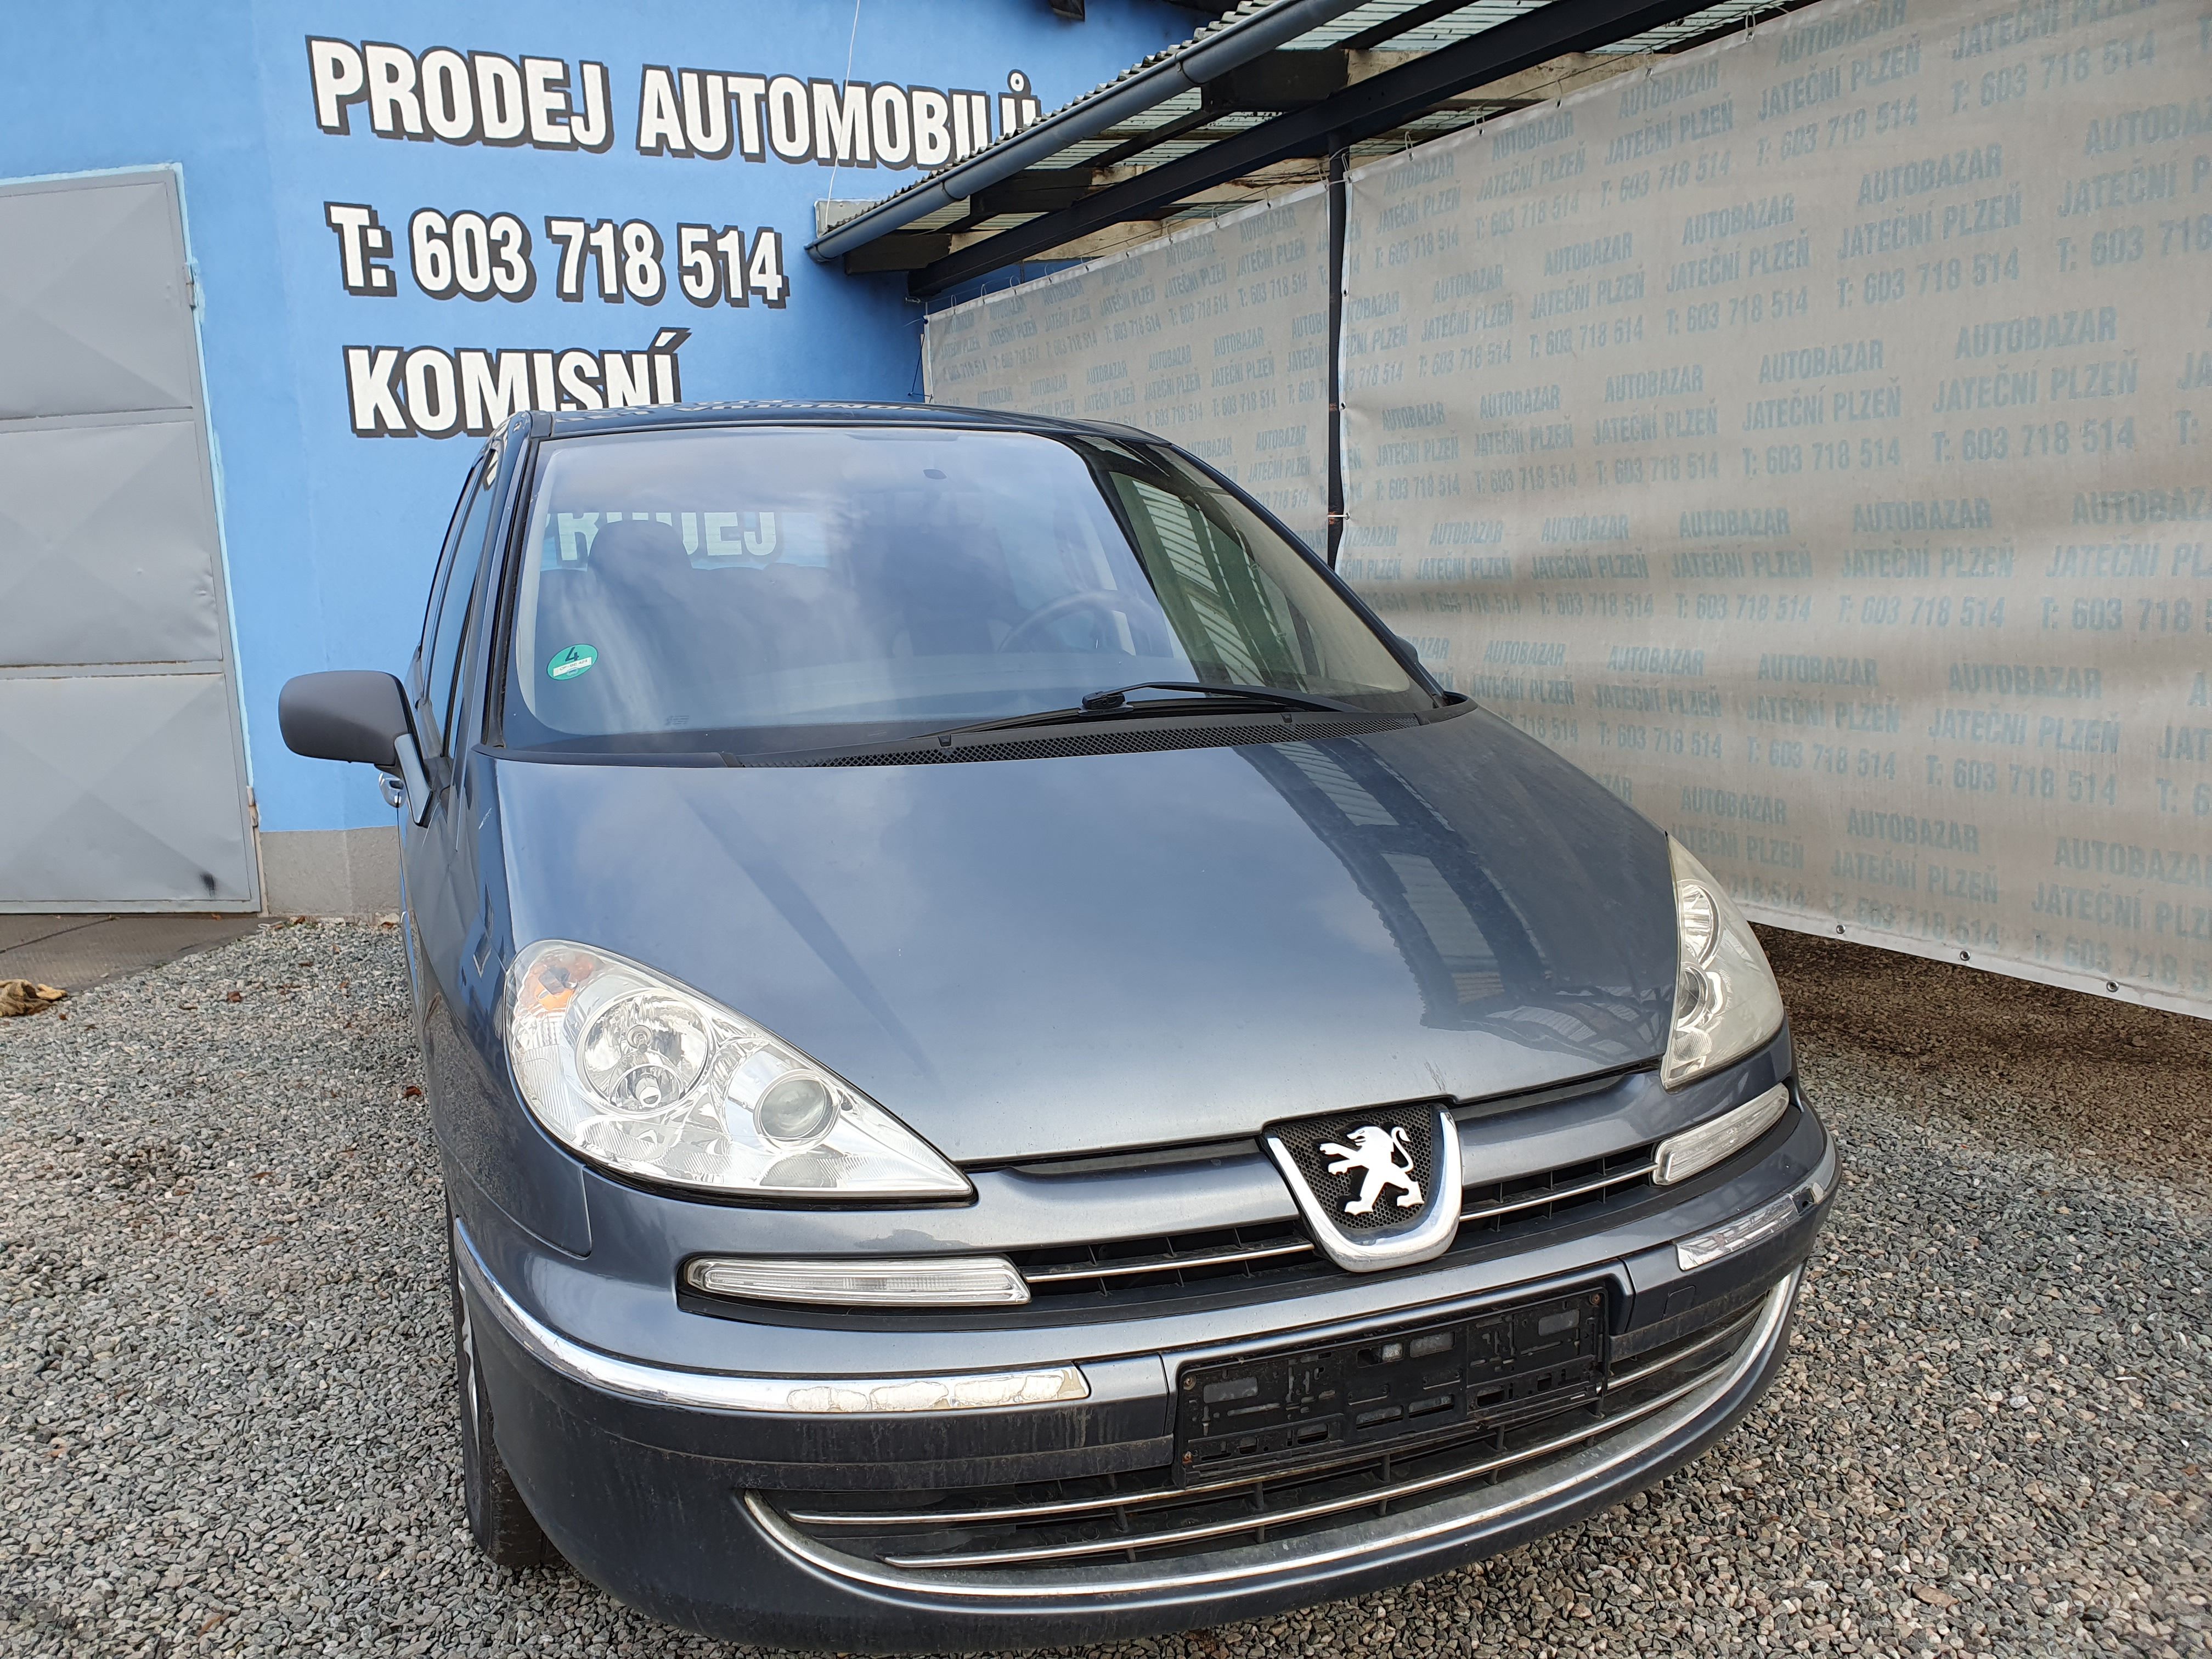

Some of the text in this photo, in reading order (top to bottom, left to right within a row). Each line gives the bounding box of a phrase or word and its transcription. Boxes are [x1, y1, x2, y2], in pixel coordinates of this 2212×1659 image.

[1619, 58, 1719, 119] AUTOBAZAR
[1758, 32, 1921, 121] JATEČNÍ PLZEŇ
[1980, 61, 2027, 106] 603
[2041, 45, 2089, 89] 718
[2102, 29, 2154, 75] 514
[305, 35, 612, 154] PRODEJ
[1605, 92, 1734, 165] JATEČNÍ PLZEŇ
[1781, 123, 1818, 161] 603
[1828, 109, 1866, 148] 718
[1876, 93, 1917, 134] 514
[1620, 170, 1649, 202] 603
[1659, 160, 1690, 192] 718
[1696, 151, 1731, 182] 514
[1858, 142, 2002, 206] AUTOBAZAR
[2056, 149, 2178, 217] JATEČNÍ
[1240, 207, 1296, 243] AUTOBAZAR
[1682, 193, 1795, 246] AUTOBAZAR
[1837, 181, 2021, 260] JATEČNÍ PLZEŇ
[325, 201, 789, 309] T: 603 718 514
[1237, 231, 1305, 276] JATEČNÍ PLZEŇ
[1544, 232, 1633, 275] AUTOBAZAR
[1667, 228, 1810, 292] JATEČNÍ PLZEŇ
[2091, 225, 2144, 267] 603
[1251, 282, 1267, 304] 603
[1271, 276, 1289, 300] 718
[1293, 271, 1308, 294] 514
[1530, 264, 1645, 319] JATEČNÍ PLZEŇ
[1864, 268, 1905, 304] 603
[1918, 258, 1960, 295] 718
[1972, 247, 2019, 286] 514
[1687, 302, 1719, 334] 603
[1729, 294, 1762, 326] 718
[1771, 285, 1808, 319] 514
[1214, 327, 1264, 357] AUTOBAZAR
[1546, 329, 1572, 356] 603
[1580, 321, 1606, 348] 718
[1955, 306, 2118, 360] AUTOBAZAR
[342, 327, 692, 439] KOMISNÍ
[1211, 351, 1275, 387] JATEČNÍ PLZEŇ
[1759, 339, 1884, 383] AUTOBAZAR
[1932, 348, 2138, 413] JATEČNÍ PLZEŇ
[1222, 394, 1237, 416] 603
[1241, 392, 1256, 412] 718
[1261, 388, 1277, 408] 514
[1604, 364, 1703, 403] AUTOBAZAR
[1742, 376, 1901, 431] JATEČNÍ PLZEŇ
[1593, 398, 1718, 445] JATEČNÍ PLZEŇ
[1962, 427, 2008, 461] 603
[2022, 420, 2070, 456] 718
[2083, 417, 2134, 453] 514
[1615, 456, 1643, 484] 603
[1650, 455, 1680, 482] 718
[1687, 451, 1718, 480] 514
[1767, 444, 1802, 474] 603
[1813, 439, 1849, 470] 718
[1860, 437, 1900, 469] 514
[1679, 507, 1791, 538] AUTOBAZAR
[1852, 497, 1993, 532] AUTOBAZAR
[1672, 541, 1813, 578] JATEČNÍ PLZEŇ
[1841, 537, 2015, 578] JATEČNÍ PLZEŇ
[2045, 532, 2162, 577] JATEČNÍ
[1696, 594, 1728, 620] 603
[1737, 594, 1769, 621] 718
[1776, 595, 1811, 622] 514
[1861, 595, 1903, 625] 603
[1910, 595, 1952, 628] 718
[1960, 596, 2005, 628] 514
[2072, 597, 2122, 631] 603
[2138, 597, 2193, 632] 718
[565, 646, 579, 661] 4
[1606, 645, 1705, 676] AUTOBAZAR
[1758, 653, 1878, 686] AUTOBAZAR
[1594, 679, 1722, 718] JATEČNÍ PLZEŇ
[1949, 663, 2102, 699] AUTOBAZAR
[1747, 690, 1900, 733] JATEČNÍ PLZEŇ
[1928, 702, 2120, 754] JATEČNÍ PLZEŇ
[1617, 723, 1646, 749] 603
[1654, 727, 1683, 754] 718
[1691, 731, 1722, 758] 514
[1769, 738, 1803, 768] 603
[1813, 743, 1848, 775] 718
[1857, 747, 1895, 780] 514
[1953, 758, 1997, 792] 603
[2009, 764, 2054, 799] 718
[2067, 769, 2116, 805] 514
[1681, 786, 1786, 824] AUTOBAZAR
[1847, 808, 1978, 854] AUTOBAZAR
[1831, 850, 1998, 904] JATEČNÍ PLZEŇ
